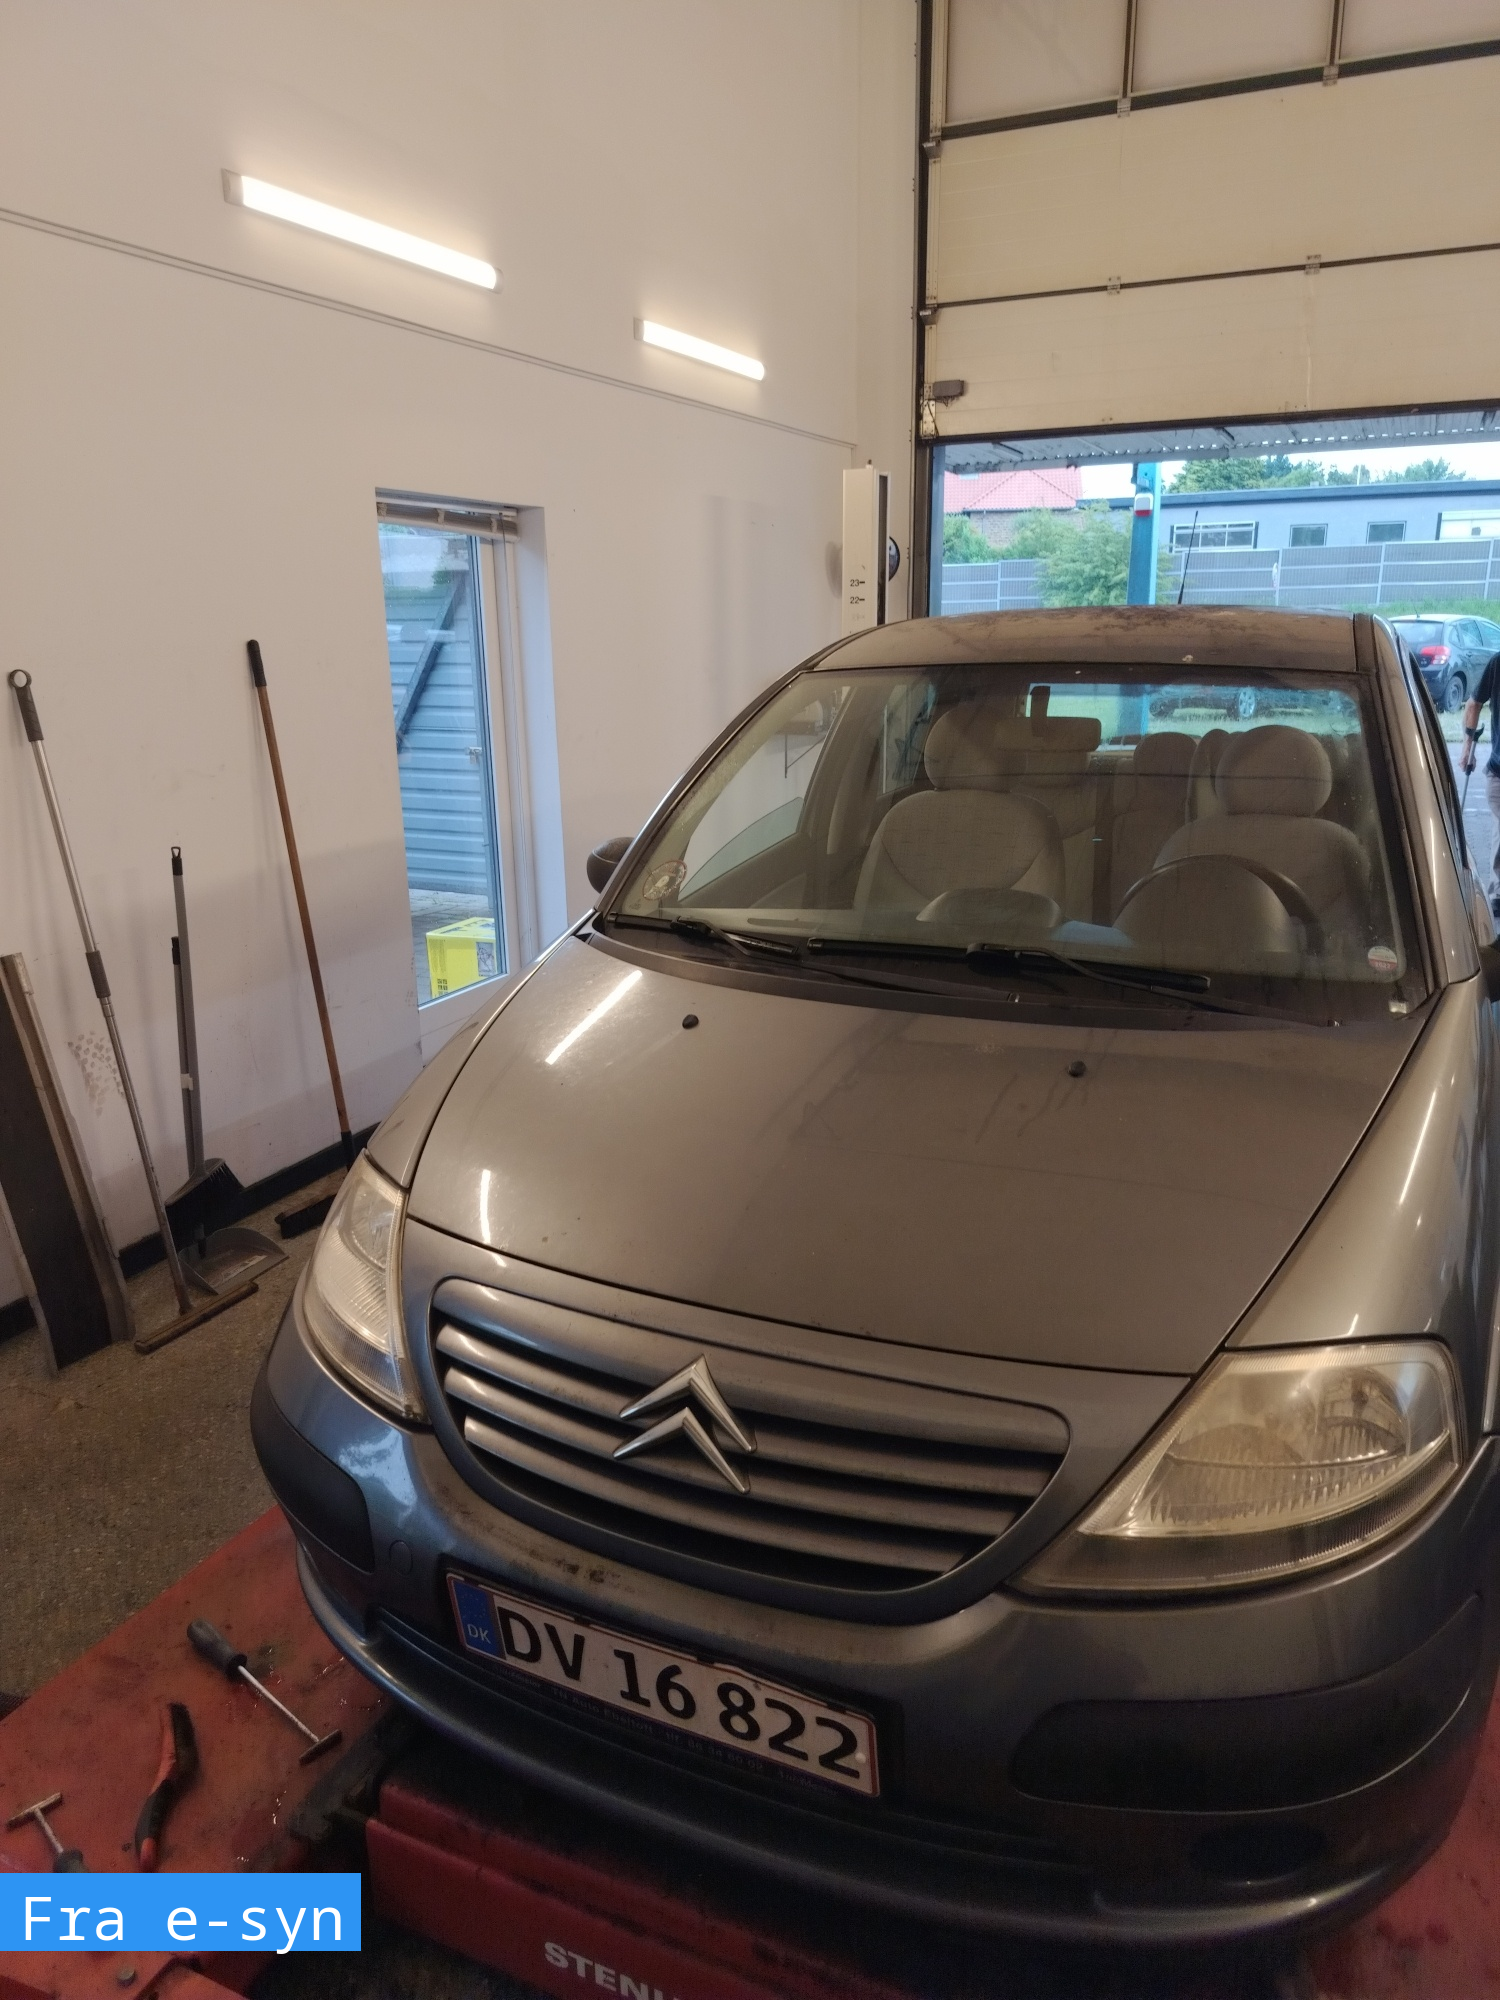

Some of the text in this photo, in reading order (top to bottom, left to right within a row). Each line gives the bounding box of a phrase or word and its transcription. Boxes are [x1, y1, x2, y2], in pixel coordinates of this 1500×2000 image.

[850, 579, 860, 587] 23
[850, 596, 860, 604] 22
[467, 1623, 490, 1644] DK
[497, 1606, 861, 1779] DV 16 822
